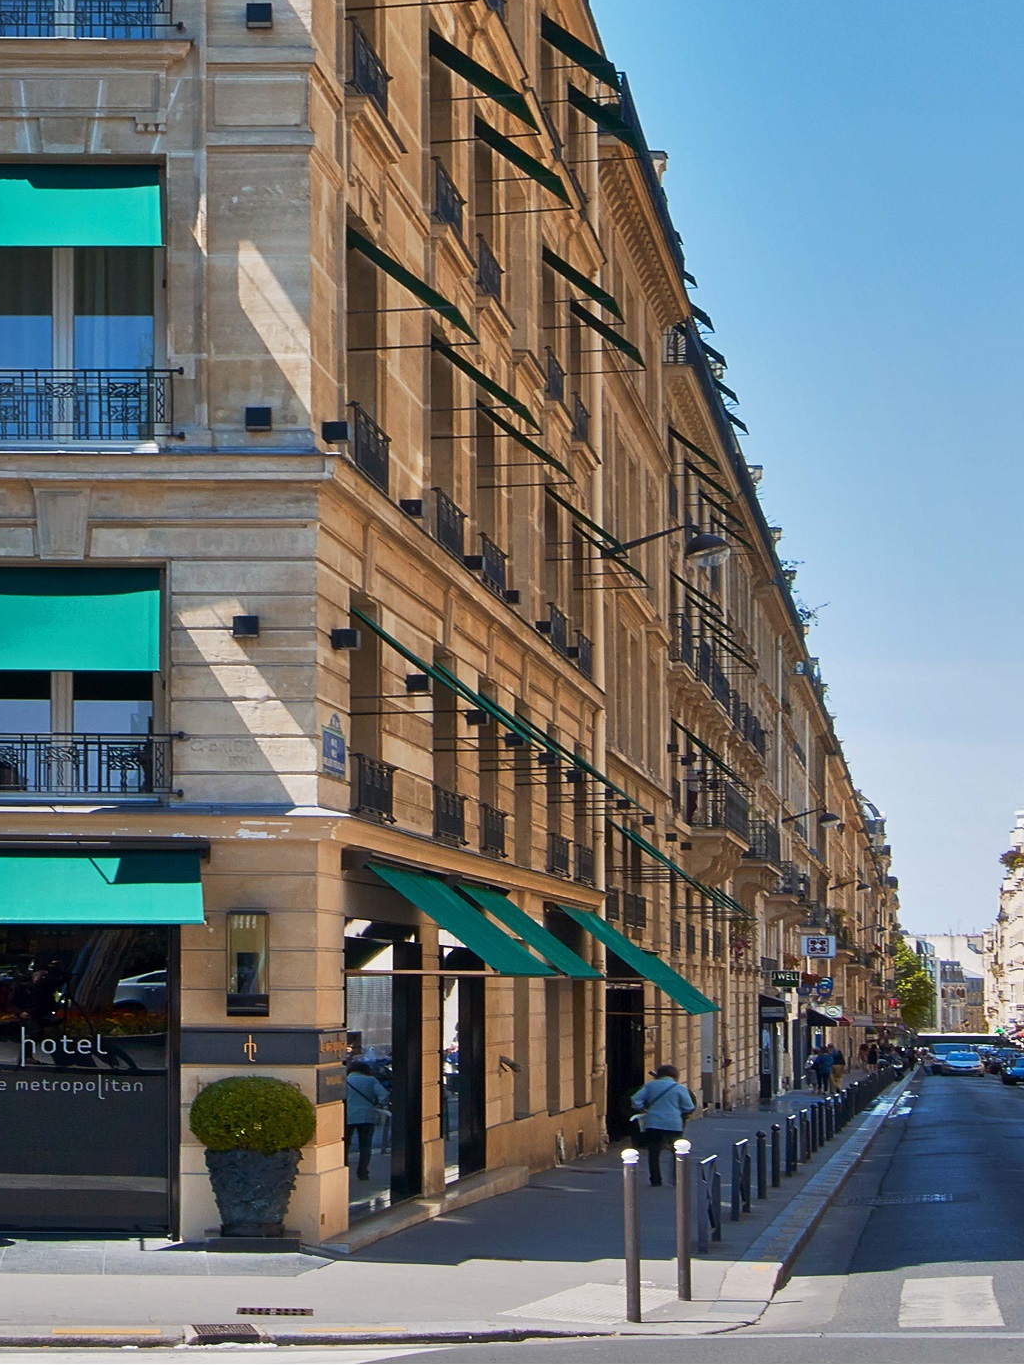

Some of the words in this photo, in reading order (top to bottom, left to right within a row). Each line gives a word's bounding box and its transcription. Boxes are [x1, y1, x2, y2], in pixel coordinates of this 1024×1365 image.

[777, 972, 799, 981] WELL
[21, 1026, 108, 1067] hotel
[15, 1074, 144, 1100] metropolitan
